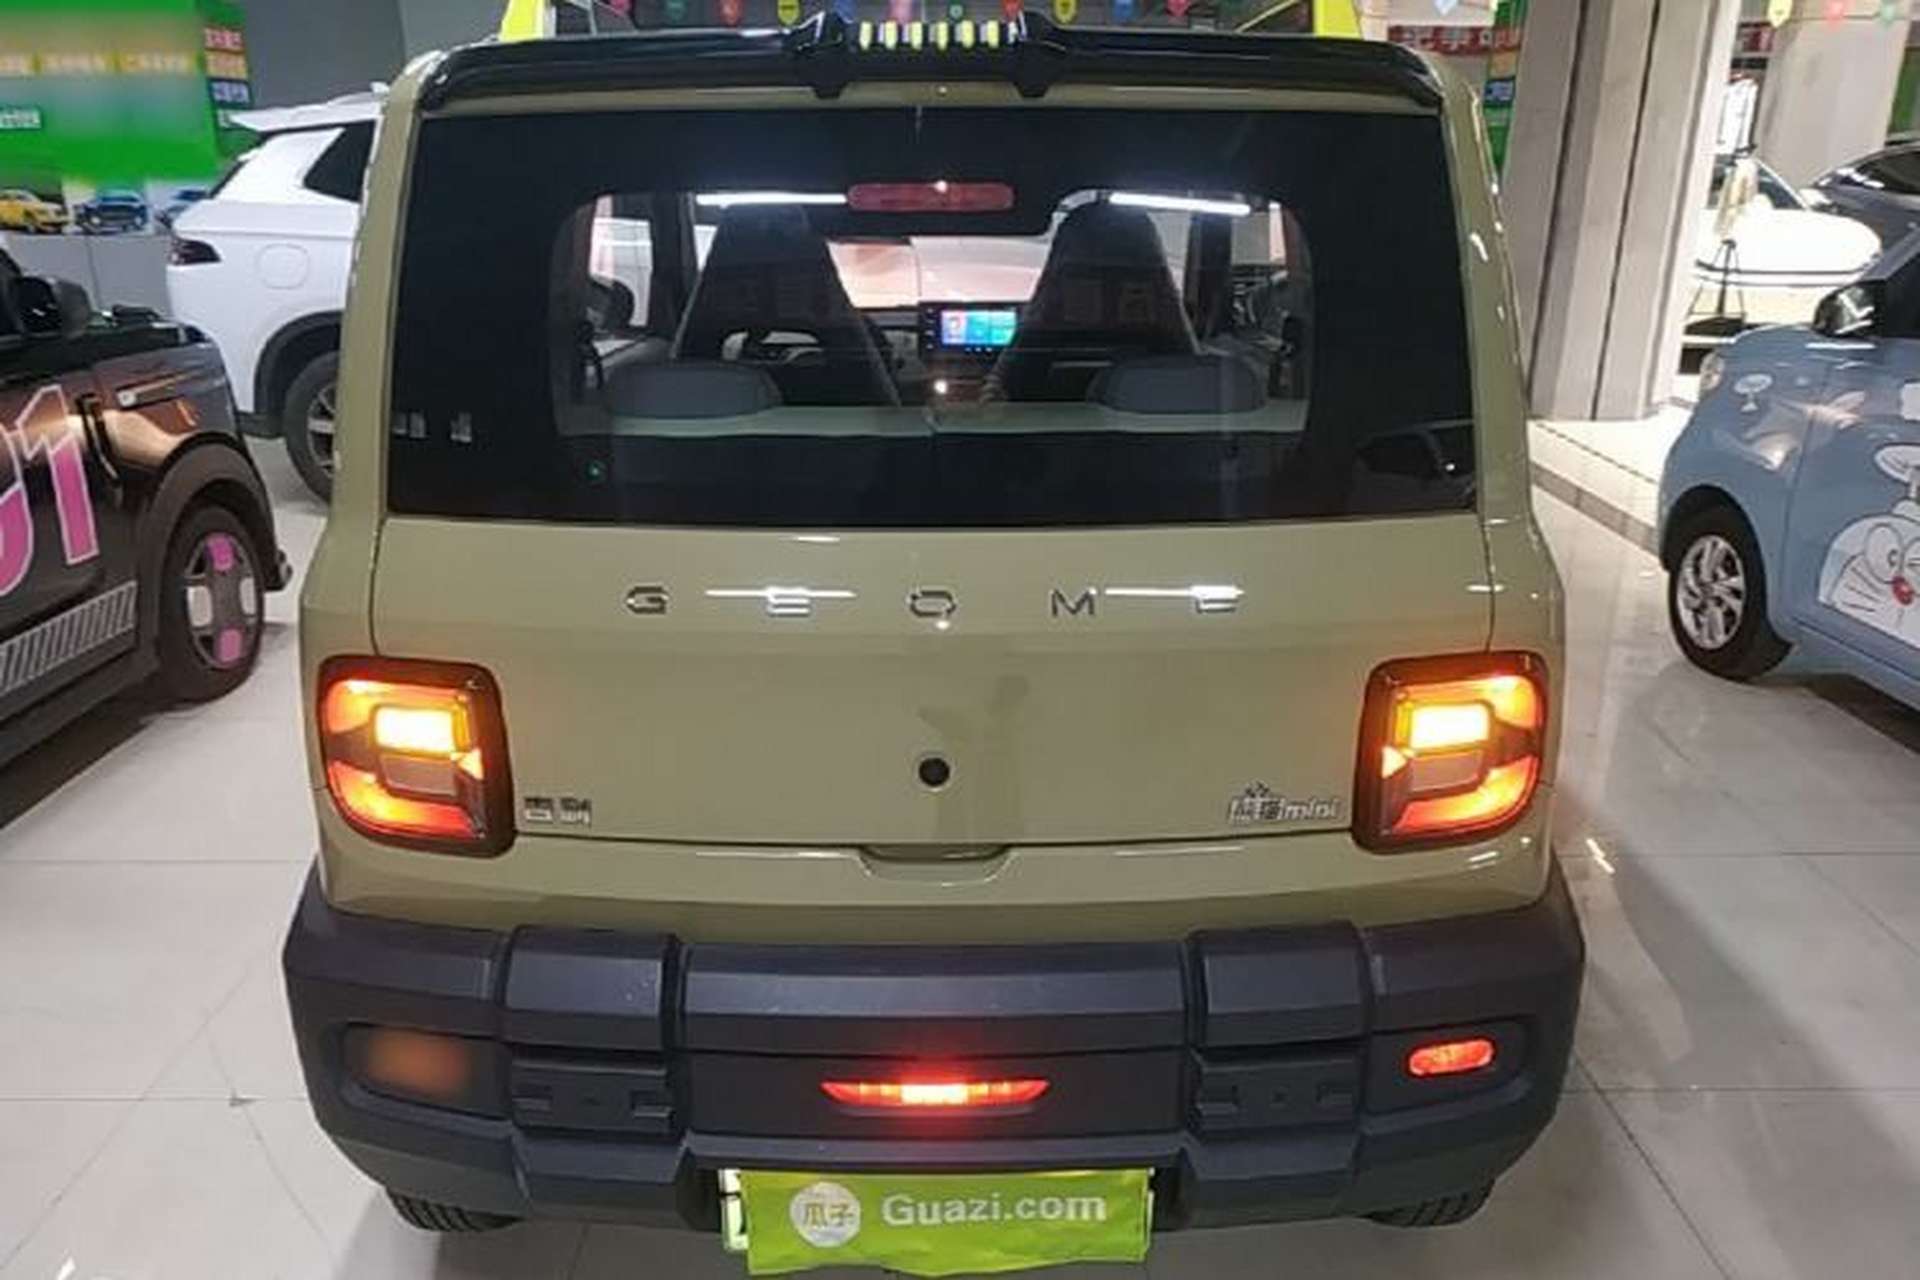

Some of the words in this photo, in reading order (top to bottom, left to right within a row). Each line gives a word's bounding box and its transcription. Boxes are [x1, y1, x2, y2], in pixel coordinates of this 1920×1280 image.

[626, 584, 1239, 616] GEOME
[806, 1201, 855, 1228] 瓜子
[883, 1192, 1107, 1226] Guazi.com
